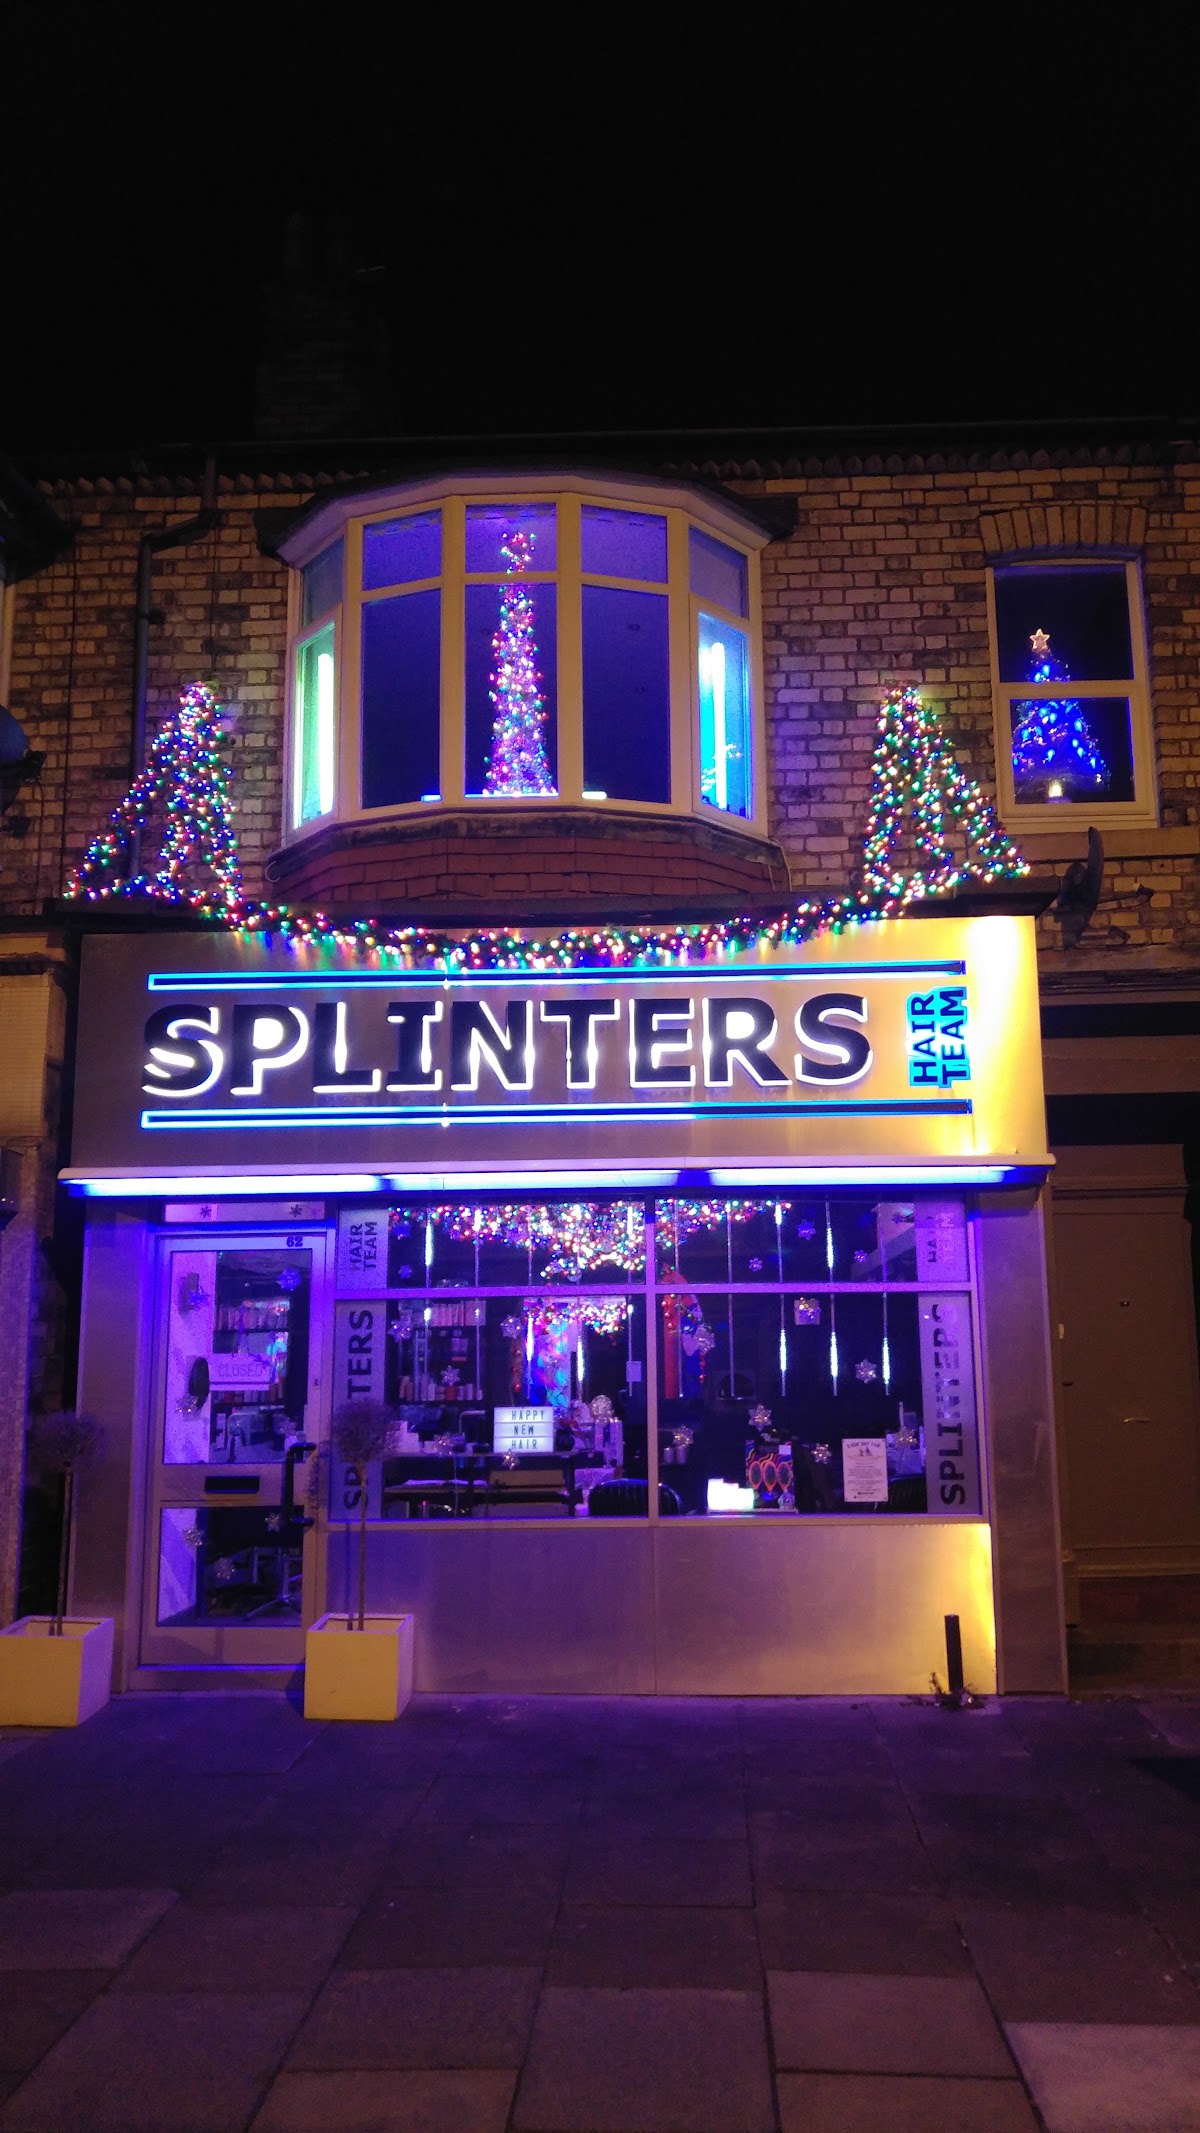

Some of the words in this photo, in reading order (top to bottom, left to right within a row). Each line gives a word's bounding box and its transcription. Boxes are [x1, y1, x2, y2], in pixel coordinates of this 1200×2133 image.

[141, 992, 873, 1098] SPLINTERS
[910, 993, 938, 1083] HAIR
[939, 989, 967, 1085] TEAM
[286, 1236, 304, 1248] 62
[363, 1221, 378, 1271] TEAM
[343, 1309, 374, 1511] SPTERS
[511, 1409, 545, 1421] HAPPY
[513, 1424, 535, 1436] NEW
[511, 1439, 538, 1450] HAIR
